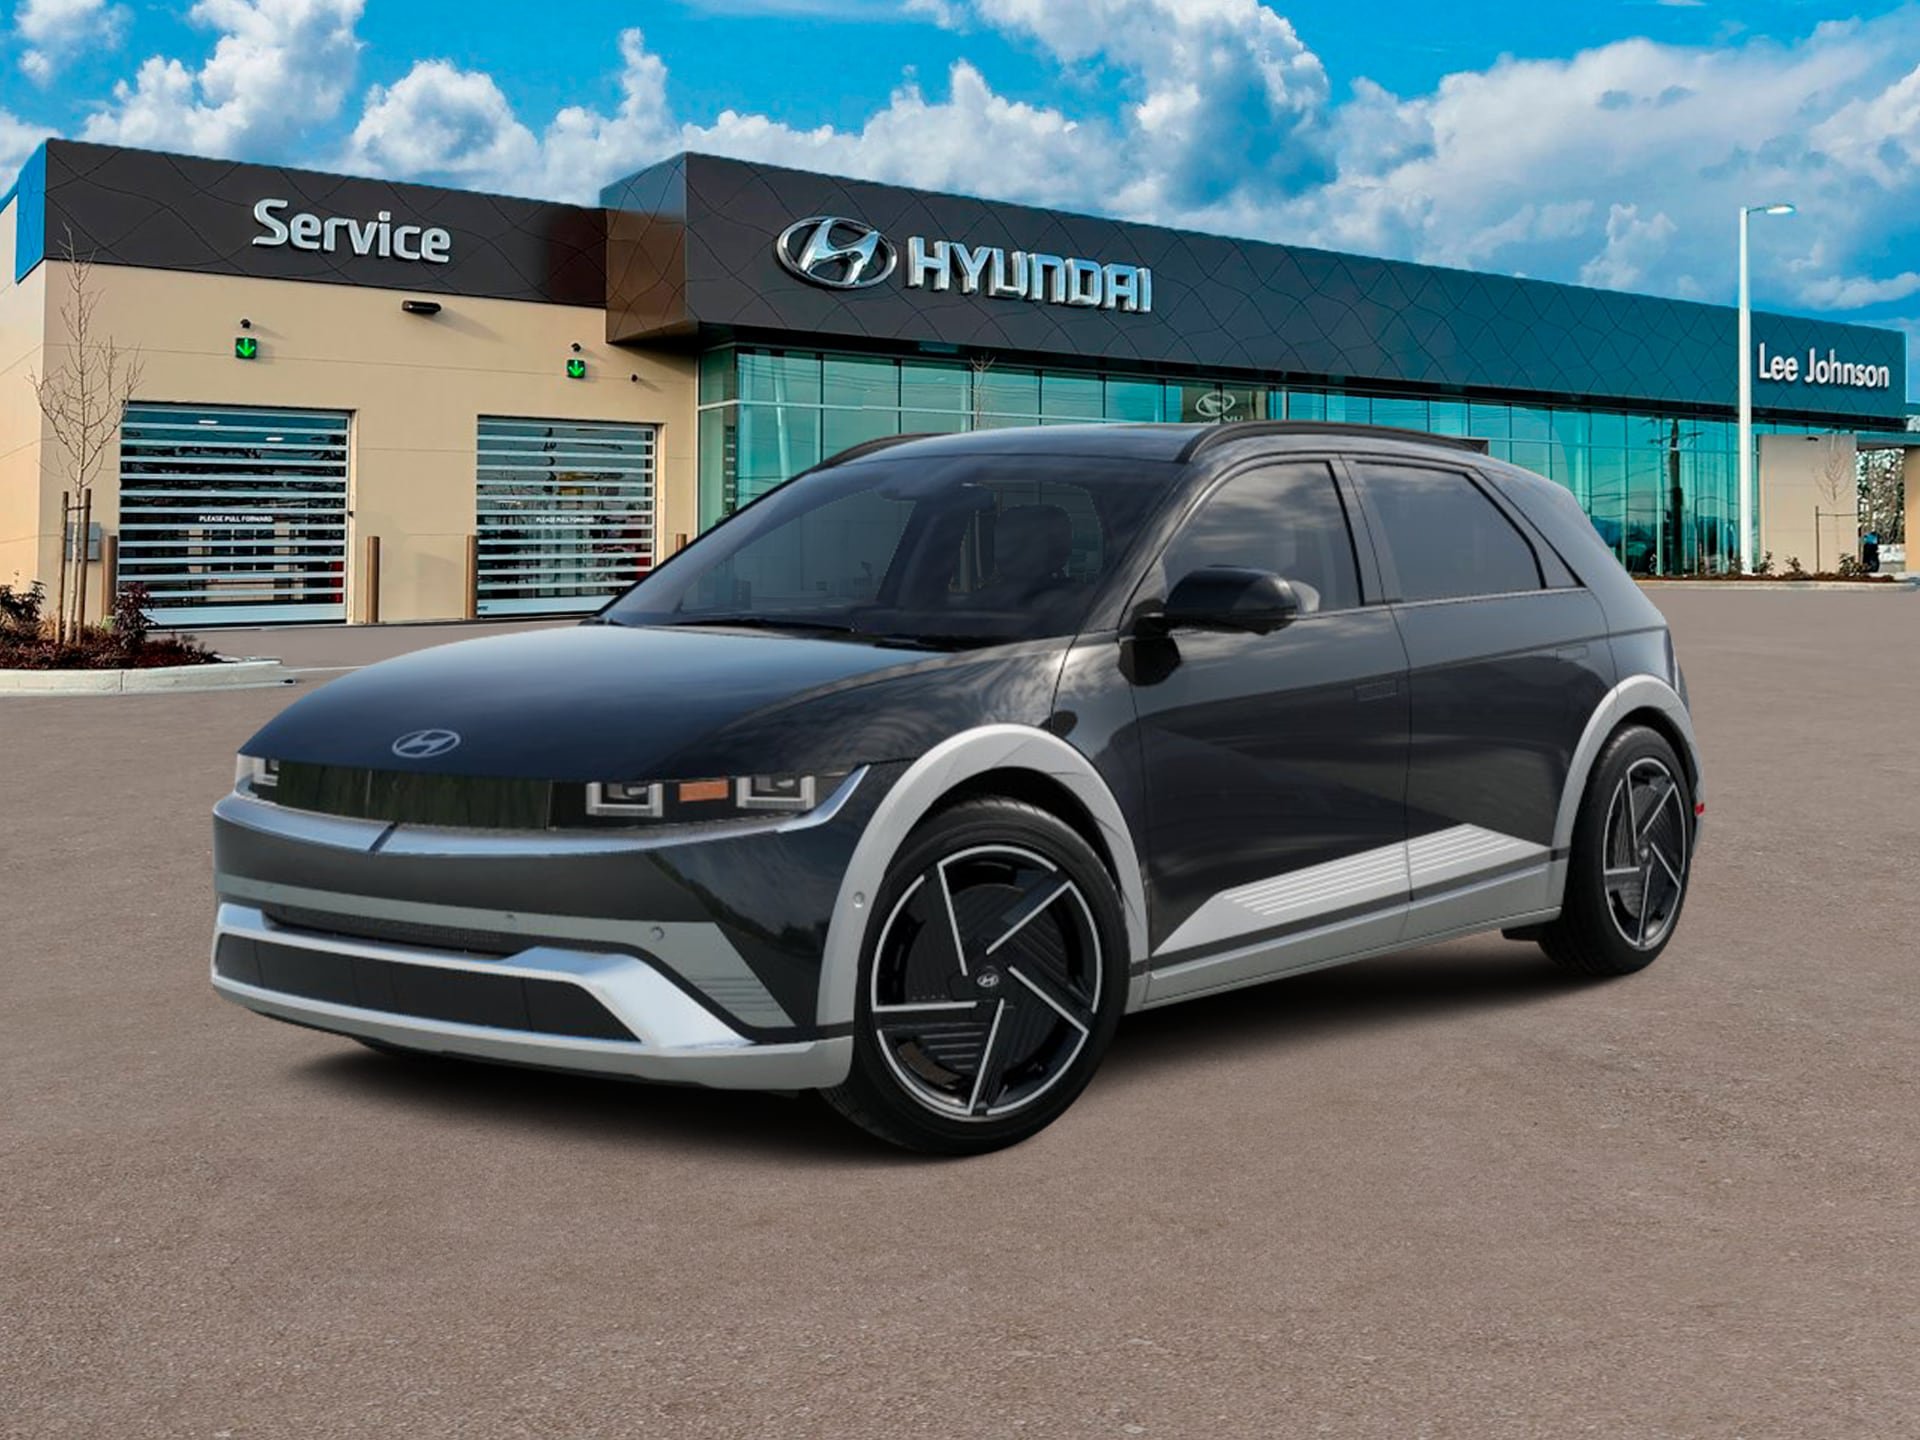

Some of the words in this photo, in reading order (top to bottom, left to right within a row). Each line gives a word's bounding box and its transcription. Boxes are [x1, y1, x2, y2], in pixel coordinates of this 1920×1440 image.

[252, 198, 451, 264] Service
[906, 236, 1152, 313] HYUNDAI
[1759, 342, 1799, 381] Lee
[1804, 347, 1890, 388] Johnson
